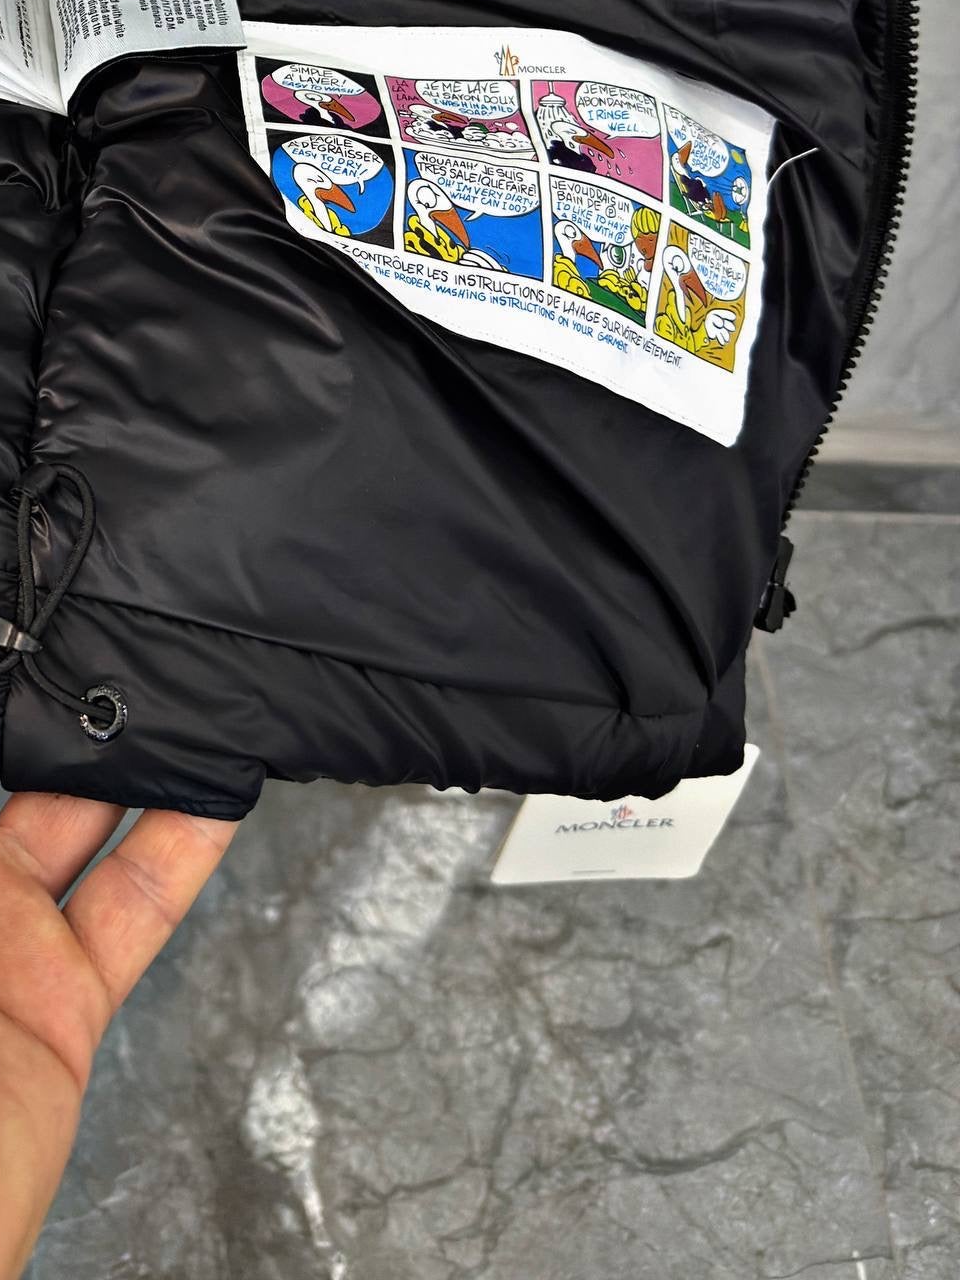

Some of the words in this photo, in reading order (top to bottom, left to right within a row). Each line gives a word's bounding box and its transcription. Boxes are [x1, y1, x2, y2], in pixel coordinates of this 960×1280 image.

[150, 0, 162, 28] ordinanza
[174, 0, 182, 13] come
[205, 4, 215, 24] bianca
[101, 15, 112, 26] and
[195, 6, 207, 31] secondo
[93, 23, 101, 36] the
[289, 64, 333, 78] SIMPLE
[517, 65, 567, 74] MONCLER
[442, 83, 462, 93] ME
[467, 82, 500, 94] LAVE
[422, 91, 440, 99] AU
[442, 92, 481, 102] SAVON
[483, 95, 515, 106] DOUX
[309, 135, 353, 148] FACILE
[291, 147, 317, 160] EASY
[321, 153, 334, 163] TO
[338, 158, 362, 170] DRY
[496, 167, 524, 182] SUIS
[450, 191, 478, 204] WHAT
[480, 197, 500, 208] CAN
[473, 186, 503, 201] VERY
[557, 190, 583, 205] BAIN
[587, 199, 602, 211] DE
[617, 201, 630, 213] UN
[571, 213, 592, 231] BATH
[593, 223, 613, 240] WITH
[572, 204, 593, 220] LIKE
[596, 214, 607, 224] TO
[607, 219, 630, 234] HAVE
[352, 246, 425, 277] CONTRÔLER
[427, 265, 449, 282] LES
[454, 273, 545, 304] INSTRUCTIONS
[546, 293, 561, 309] DE
[563, 300, 601, 324] LAVAGE
[601, 317, 621, 335] SUR
[374, 265, 391, 278] THE
[393, 272, 432, 292] PROPER
[435, 284, 487, 302] WASHING
[489, 292, 555, 321] INSTRUCTIONS
[557, 315, 569, 328] ON
[572, 320, 594, 338] YOUR
[554, 817, 675, 833] MONCLER
